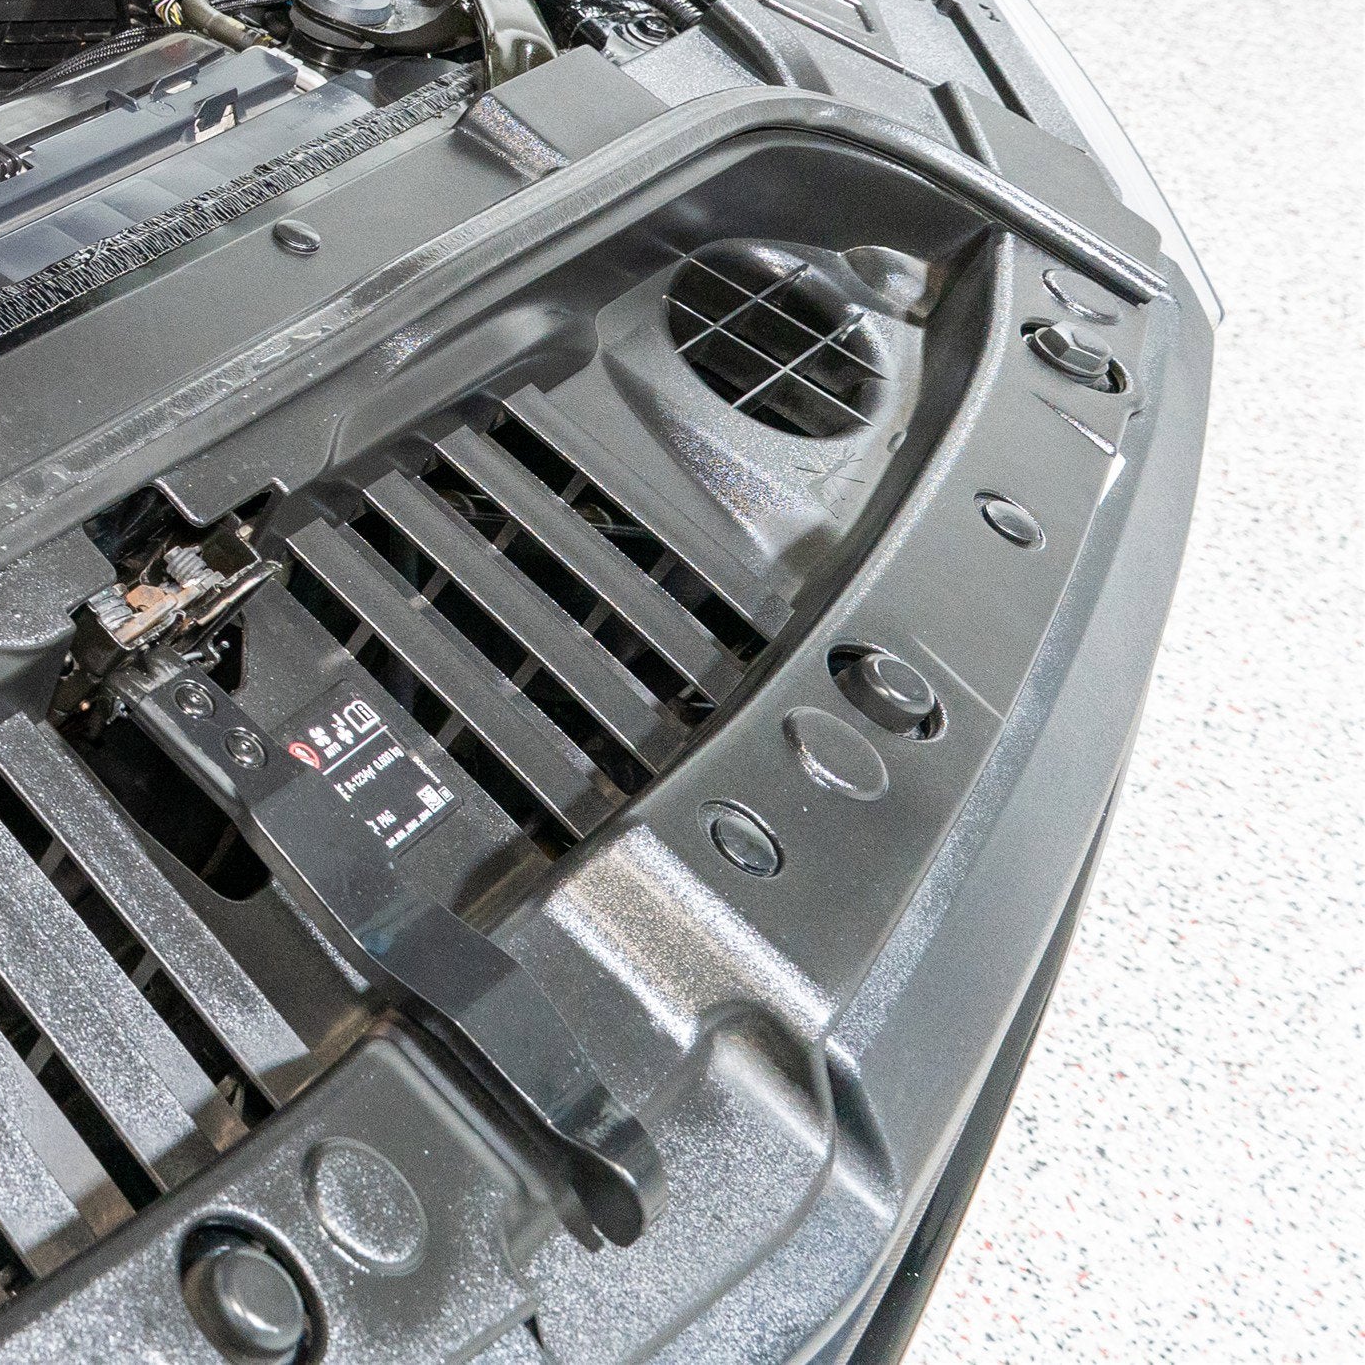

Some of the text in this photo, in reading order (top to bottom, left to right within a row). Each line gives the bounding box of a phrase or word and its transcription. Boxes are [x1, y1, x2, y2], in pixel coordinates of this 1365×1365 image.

[323, 741, 343, 759] AUTO
[344, 764, 376, 793] R-1234yf
[388, 746, 404, 759] kg
[376, 809, 397, 829] PAG
